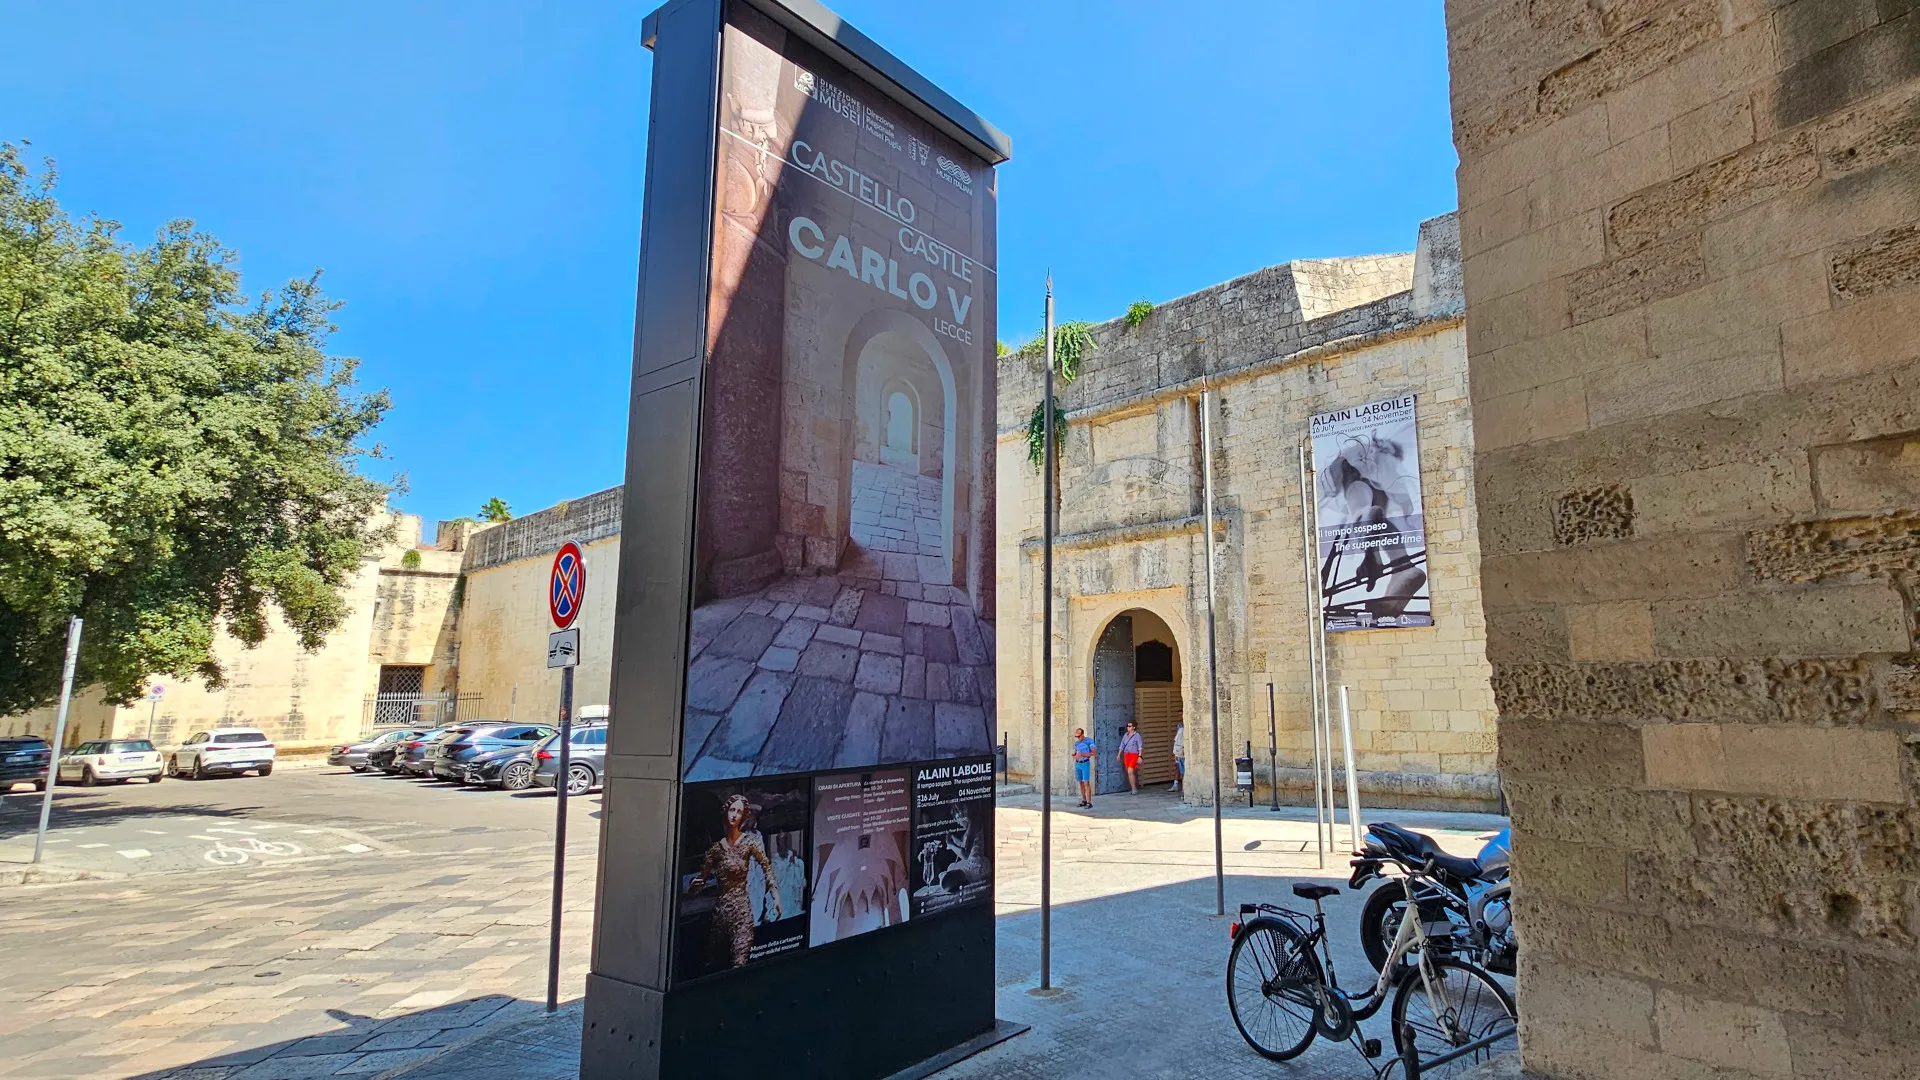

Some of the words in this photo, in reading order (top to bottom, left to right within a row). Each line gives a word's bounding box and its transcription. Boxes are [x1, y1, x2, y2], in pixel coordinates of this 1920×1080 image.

[820, 79, 861, 107] DIREZIONE
[820, 86, 860, 112] GENERALE
[820, 91, 860, 126] MUSEI
[866, 107, 894, 130] Direzione
[866, 117, 895, 139] Regionale
[866, 125, 884, 140] Musei
[792, 140, 915, 224] CASTELLO
[936, 168, 952, 184] MUSEI
[953, 178, 973, 197] ITALIANI
[898, 227, 973, 283] CASTLE
[789, 216, 937, 310] CARLO
[948, 286, 972, 325] V
[935, 316, 972, 345] LECCE
[1312, 410, 1350, 427] ALAIN
[1355, 397, 1412, 417] LABOILE
[1321, 424, 1335, 432] July
[1362, 416, 1371, 424] 04
[1373, 408, 1412, 421] November
[1325, 527, 1352, 538] tempo
[1354, 522, 1388, 534] sospeso
[1335, 543, 1351, 553] The
[1352, 535, 1399, 550] suspended
[1400, 535, 1422, 544] time
[918, 767, 950, 781] ALAIN
[952, 763, 992, 777] LABOILE
[961, 776, 983, 785] suspended
[838, 781, 862, 789] APERTURA
[921, 794, 928, 802] 16
[928, 793, 940, 802] July
[959, 789, 966, 797] 04
[966, 786, 992, 795] November
[841, 811, 860, 819] GUIDATE
[750, 944, 768, 952] Museo
[767, 940, 779, 948] della
[779, 934, 803, 945] cartapesta
